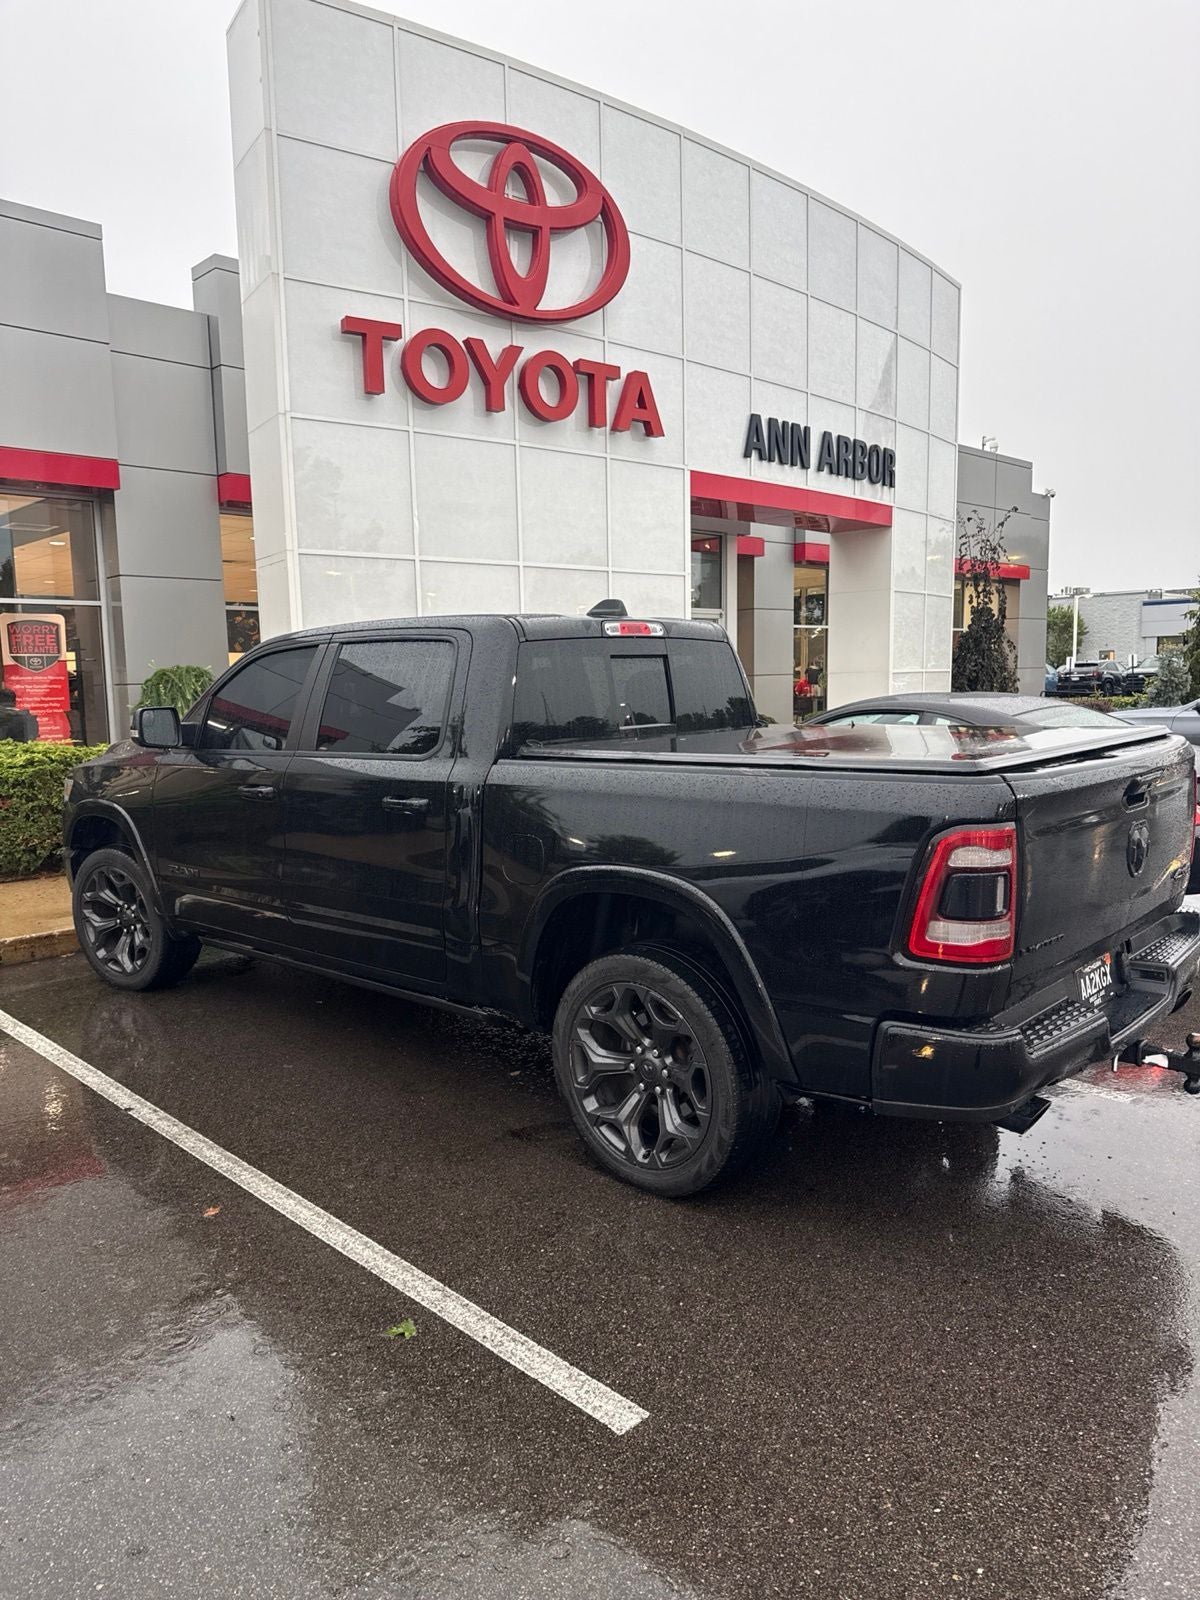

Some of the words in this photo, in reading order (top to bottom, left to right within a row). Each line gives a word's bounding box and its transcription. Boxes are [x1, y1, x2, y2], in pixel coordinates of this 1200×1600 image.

[341, 316, 665, 438] TOYOTA
[744, 413, 811, 469] ANN
[818, 430, 896, 488] ARBOR
[9, 624, 58, 634] WORRY
[11, 634, 57, 646] FREE
[12, 646, 59, 654] GUARANTEE
[1080, 963, 1113, 1001] AA2KGX
